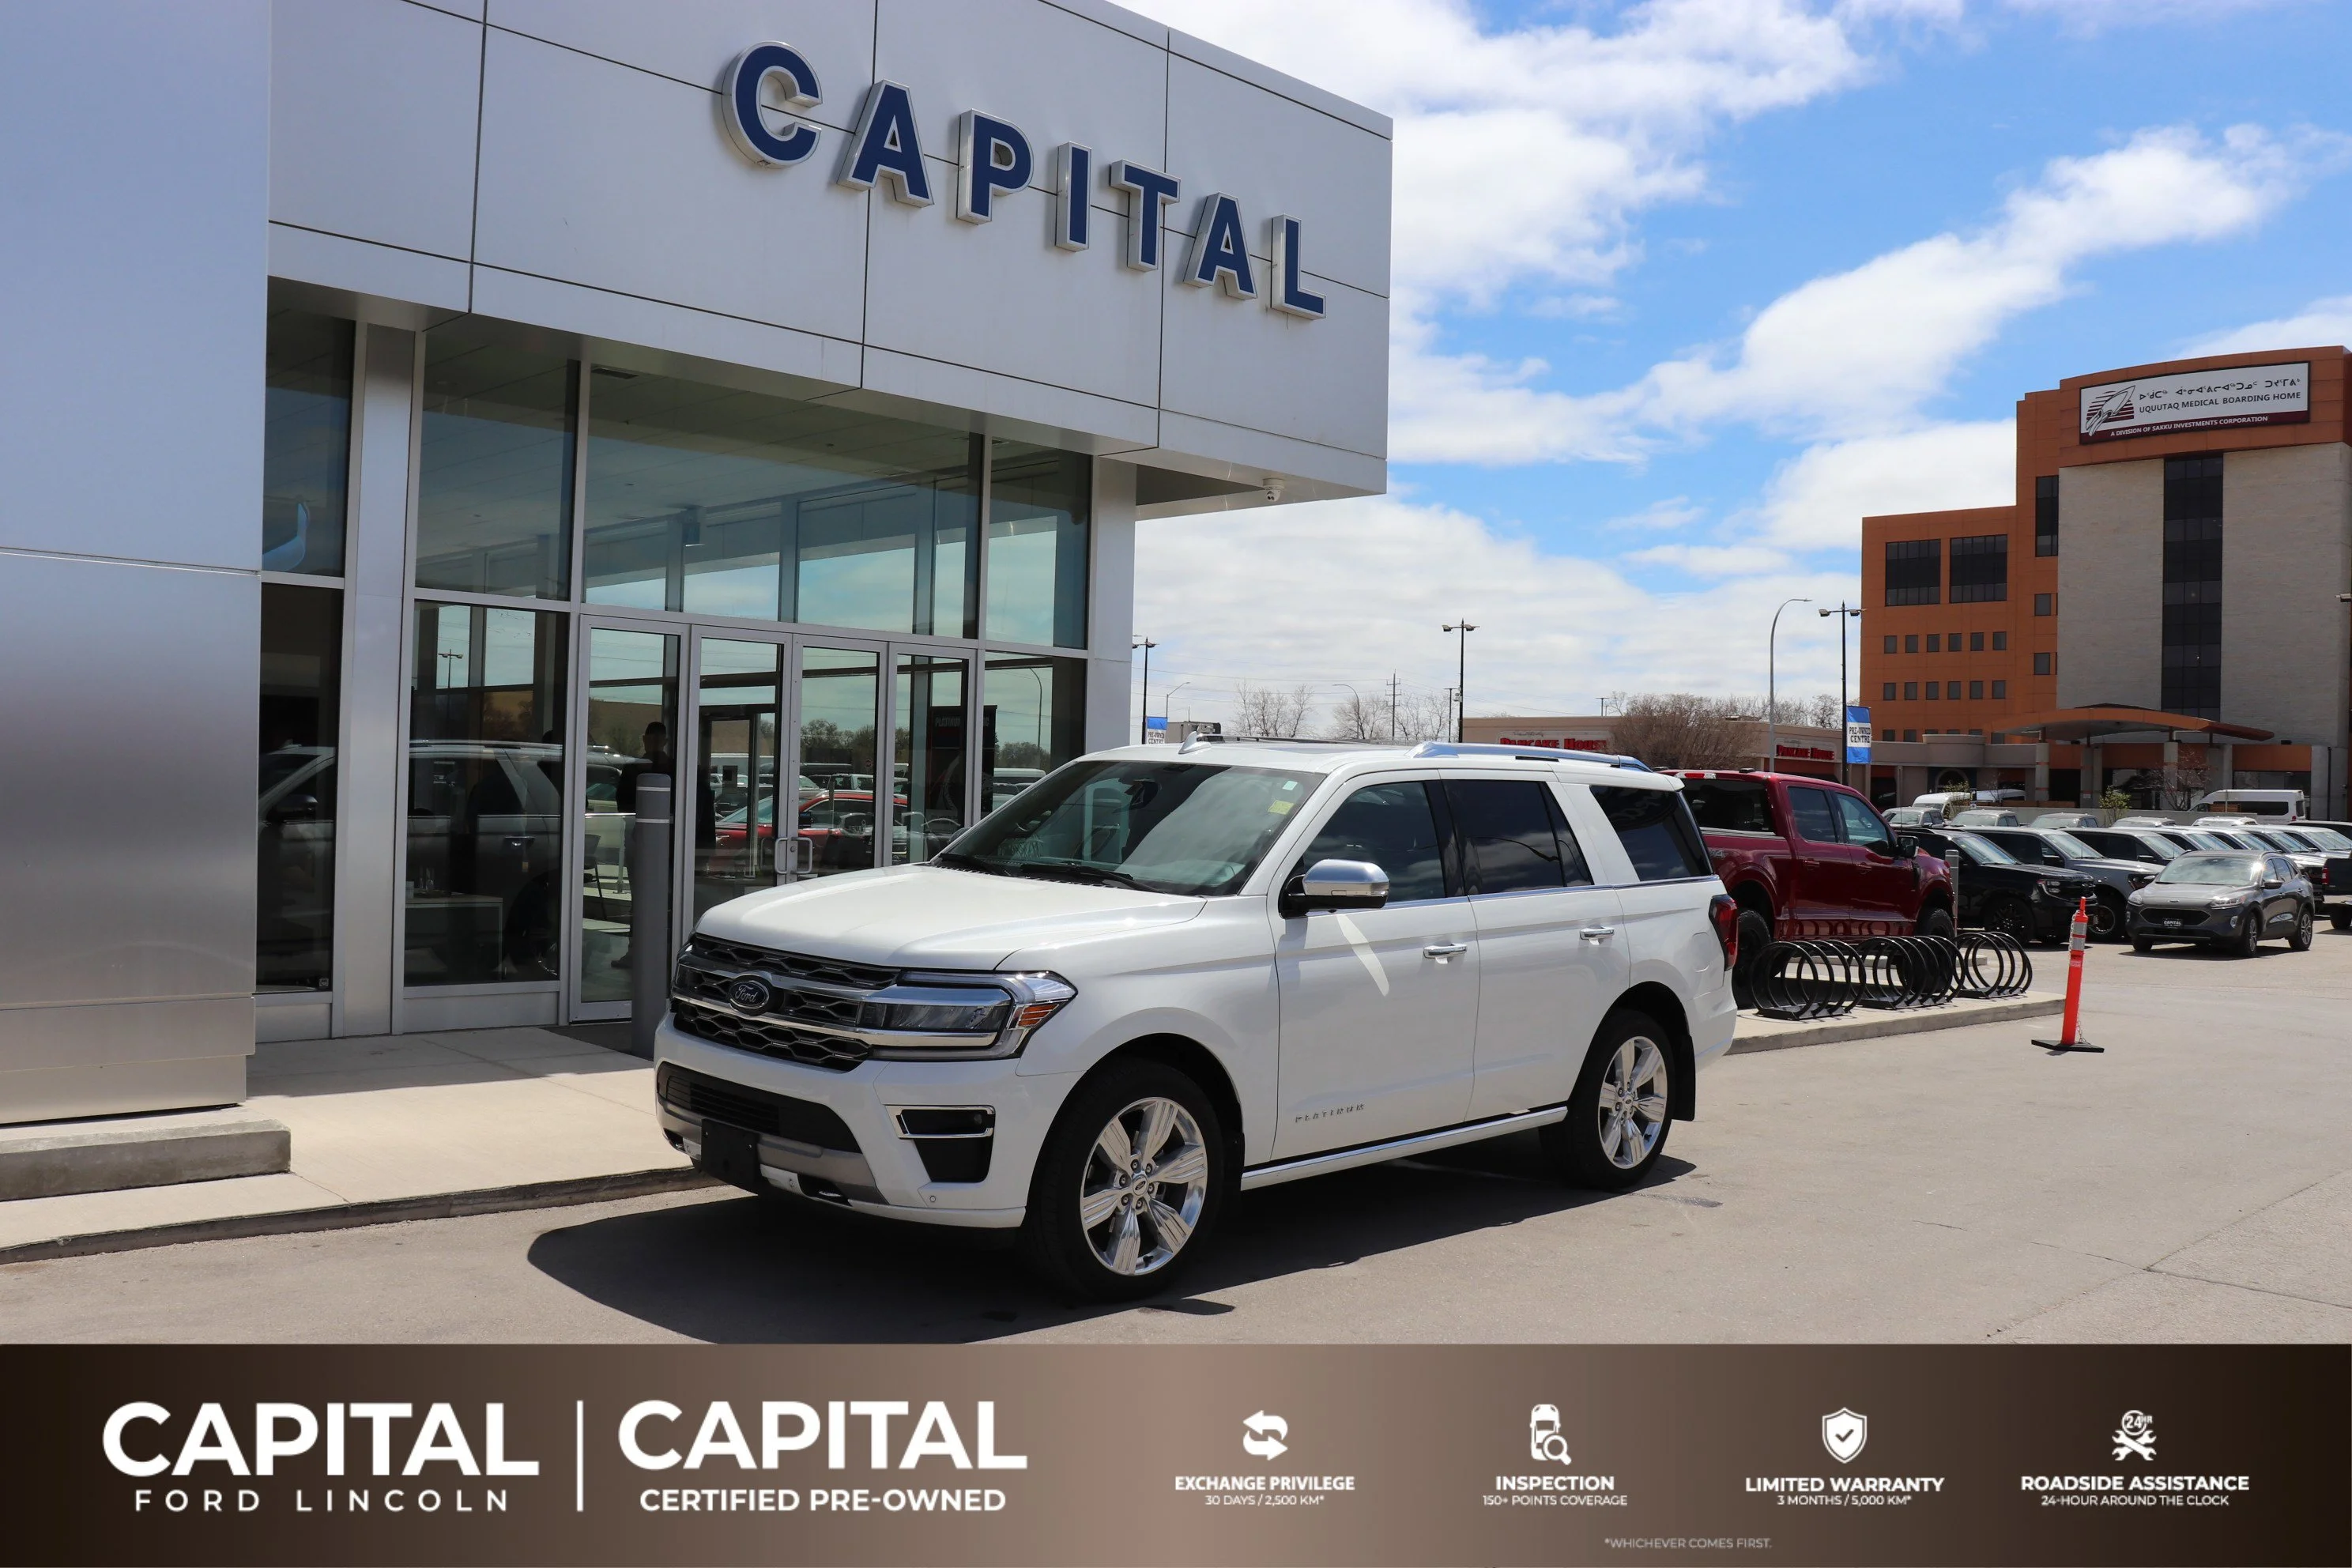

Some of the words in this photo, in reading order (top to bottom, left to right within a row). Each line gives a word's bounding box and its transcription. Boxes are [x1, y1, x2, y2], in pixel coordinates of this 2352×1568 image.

[722, 41, 1326, 320] CAPITAL
[2139, 402, 2180, 413] UQUUTAQ
[2181, 398, 2219, 409] MEDICAL
[2222, 394, 2271, 405] BOARDING
[2273, 391, 2301, 401] HOME
[2173, 419, 2218, 429] INVESTMENTS
[2219, 416, 2268, 424] CORPORATION
[1849, 726, 1871, 735] PRE-OWNED
[1850, 735, 1871, 744] CENTRE
[735, 984, 758, 1003] Ford
